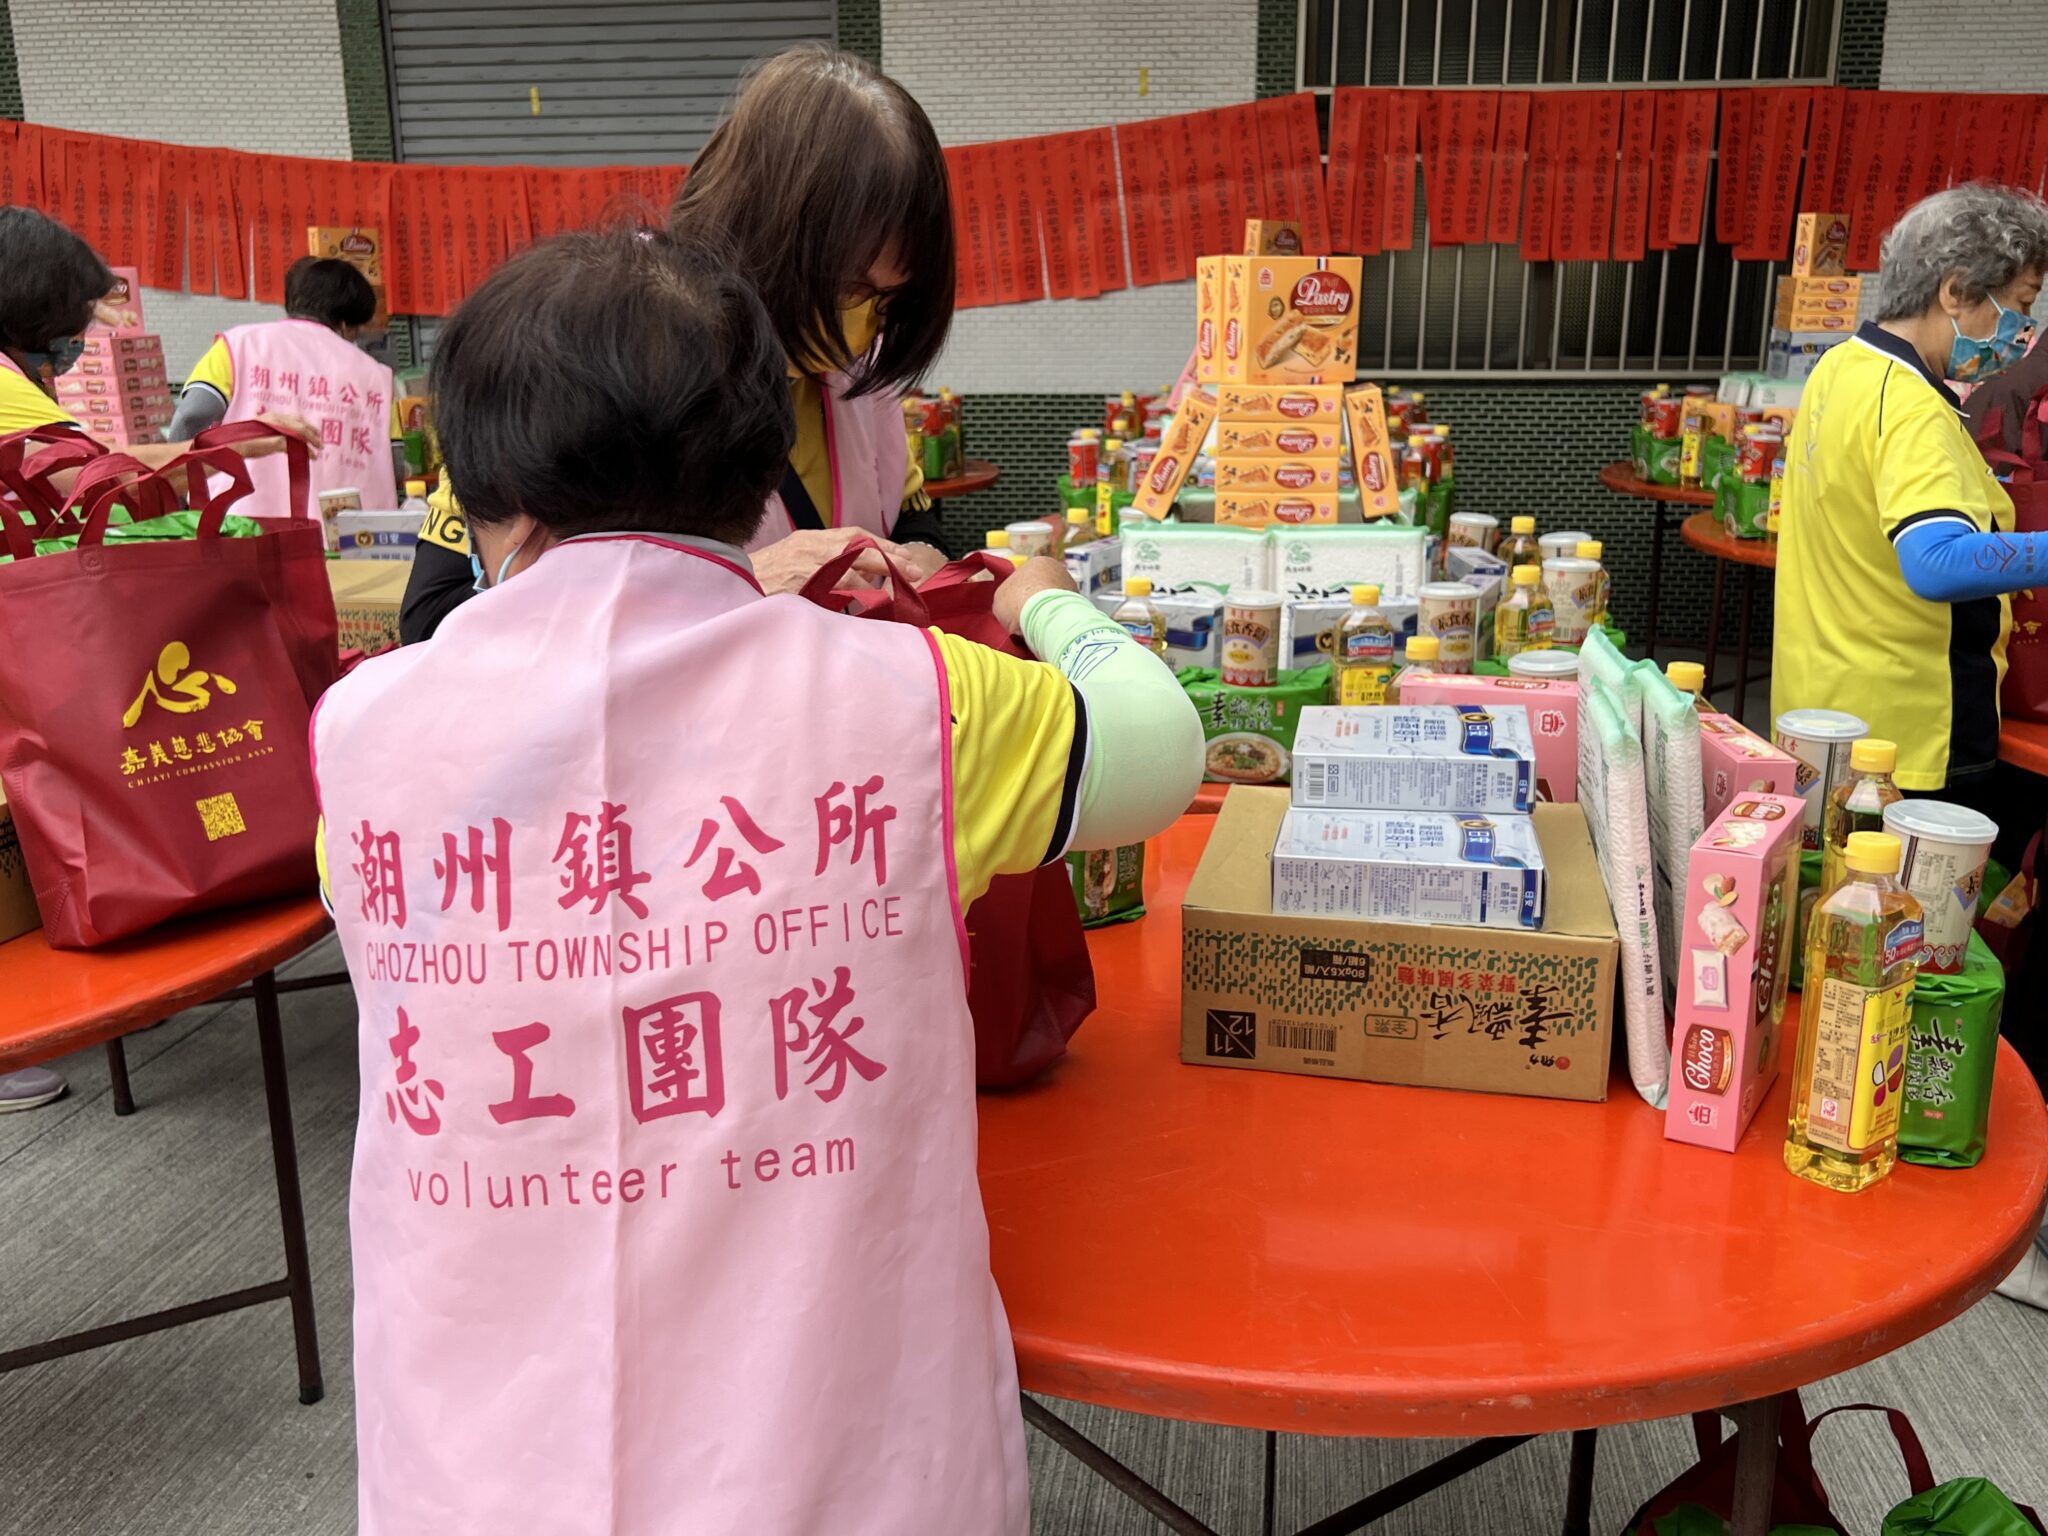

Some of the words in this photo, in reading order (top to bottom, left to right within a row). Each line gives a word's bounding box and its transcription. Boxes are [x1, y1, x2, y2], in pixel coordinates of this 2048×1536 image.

[1295, 276, 1350, 313] Pastry
[250, 364, 384, 415] 潮州鎮公所
[350, 774, 897, 931] 潮州鎮公所
[366, 943, 487, 984] CHOZHOU
[508, 920, 728, 982] TOWNSHIP
[753, 896, 904, 955] OFFICE
[386, 966, 888, 1136] 志工團隊
[1427, 984, 1575, 1050] 素飄香
[1685, 1028, 1715, 1090] Choco
[408, 1160, 677, 1208] volunteer
[720, 1136, 856, 1189] team
